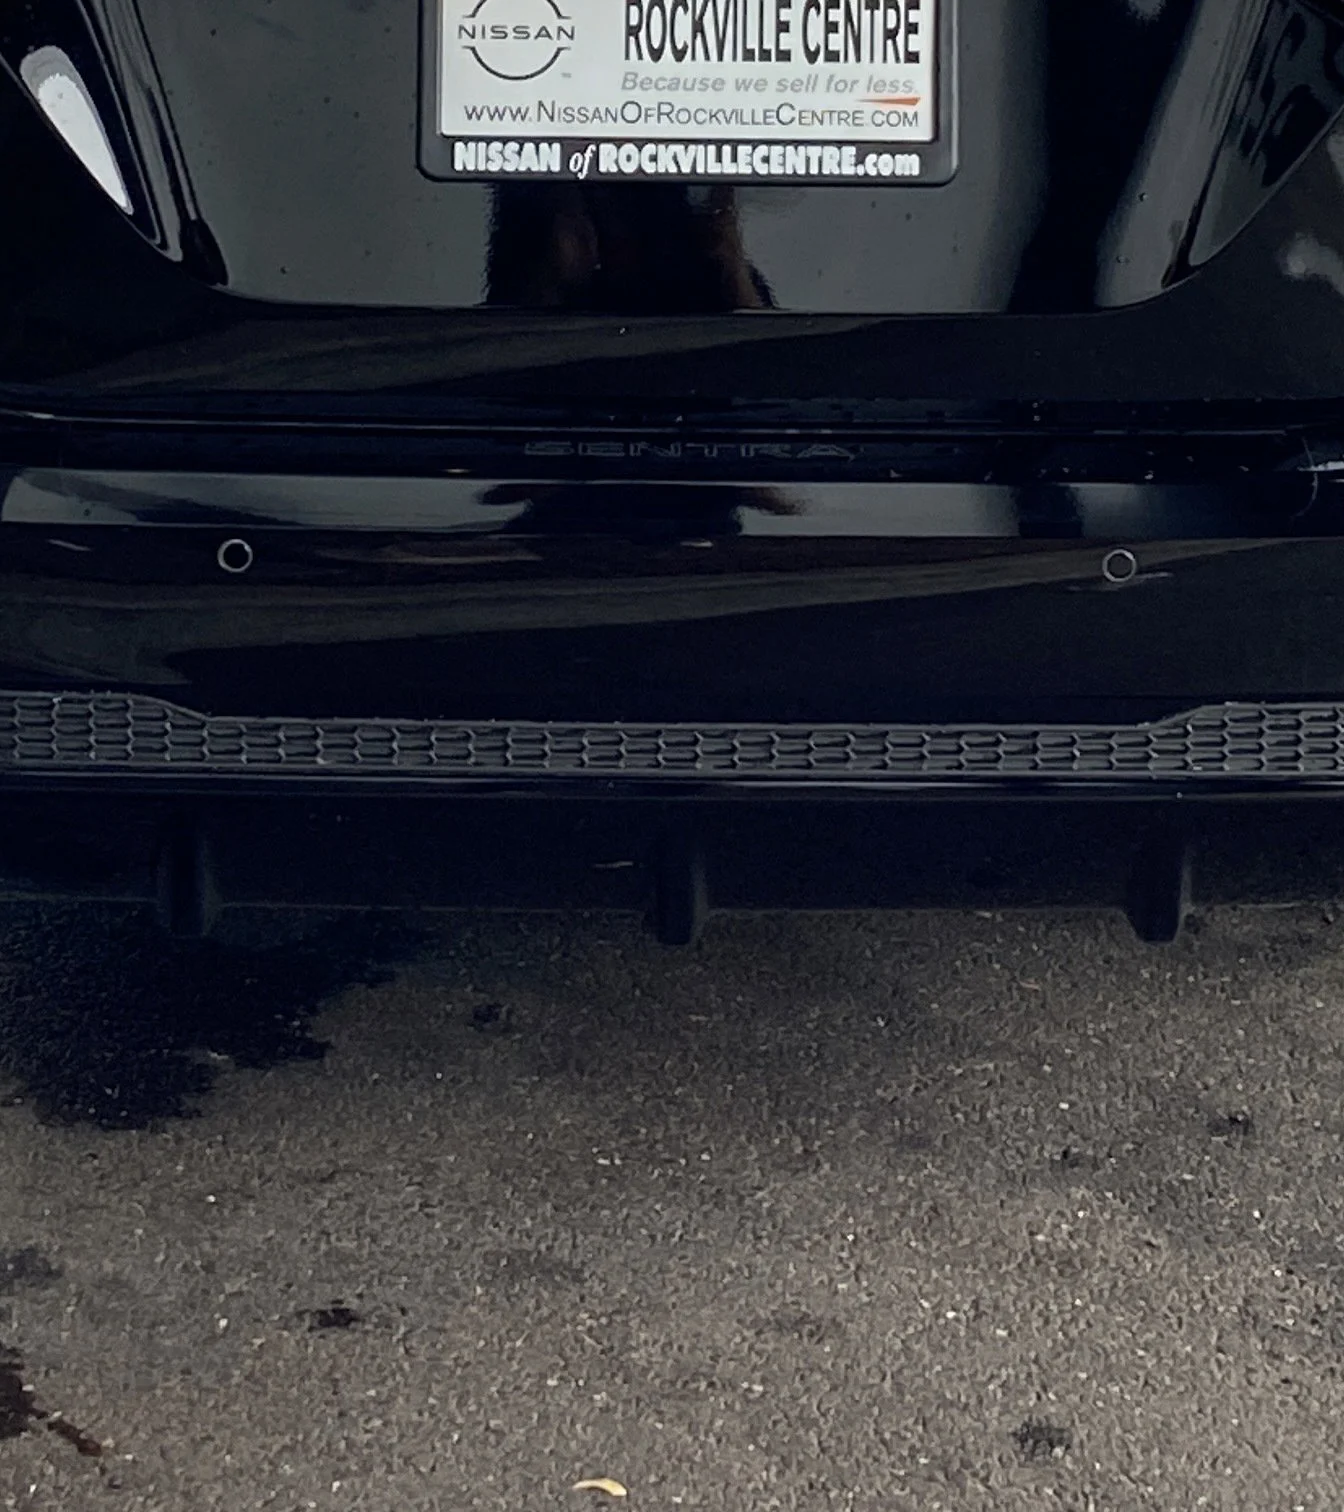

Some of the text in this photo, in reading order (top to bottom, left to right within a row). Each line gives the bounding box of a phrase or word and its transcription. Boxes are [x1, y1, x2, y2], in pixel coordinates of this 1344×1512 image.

[458, 24, 575, 41] NISSAN
[621, 71, 726, 93] Because
[735, 77, 769, 93] we
[777, 74, 819, 94] sell
[825, 74, 861, 95] for
[454, 141, 921, 181] NISSAN of ROCKVILLECENTRE.com
[523, 441, 856, 462] SENTRA
